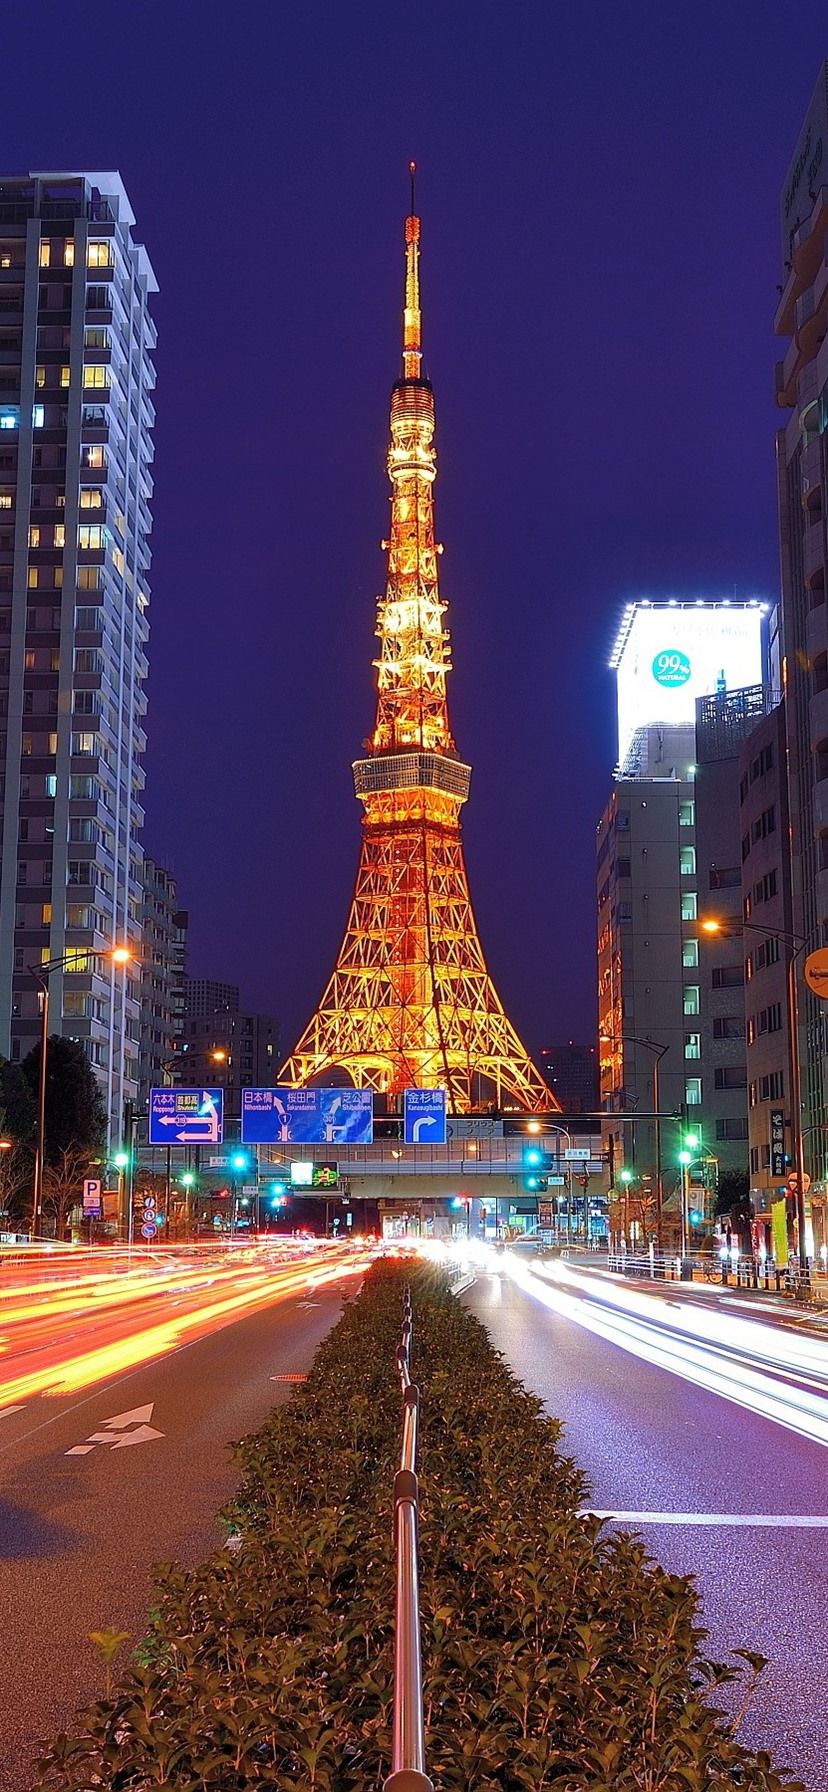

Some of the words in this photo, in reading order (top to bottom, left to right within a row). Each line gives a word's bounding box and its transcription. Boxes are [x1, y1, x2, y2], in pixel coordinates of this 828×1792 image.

[657, 654, 690, 675] 99%
[153, 1094, 175, 1105] 六本木
[244, 1091, 273, 1103] 日本橋
[287, 1091, 316, 1103] 桜田門
[342, 1091, 371, 1104] 芝公園
[407, 1091, 443, 1104] 金杉橋
[87, 1182, 98, 1196] P
